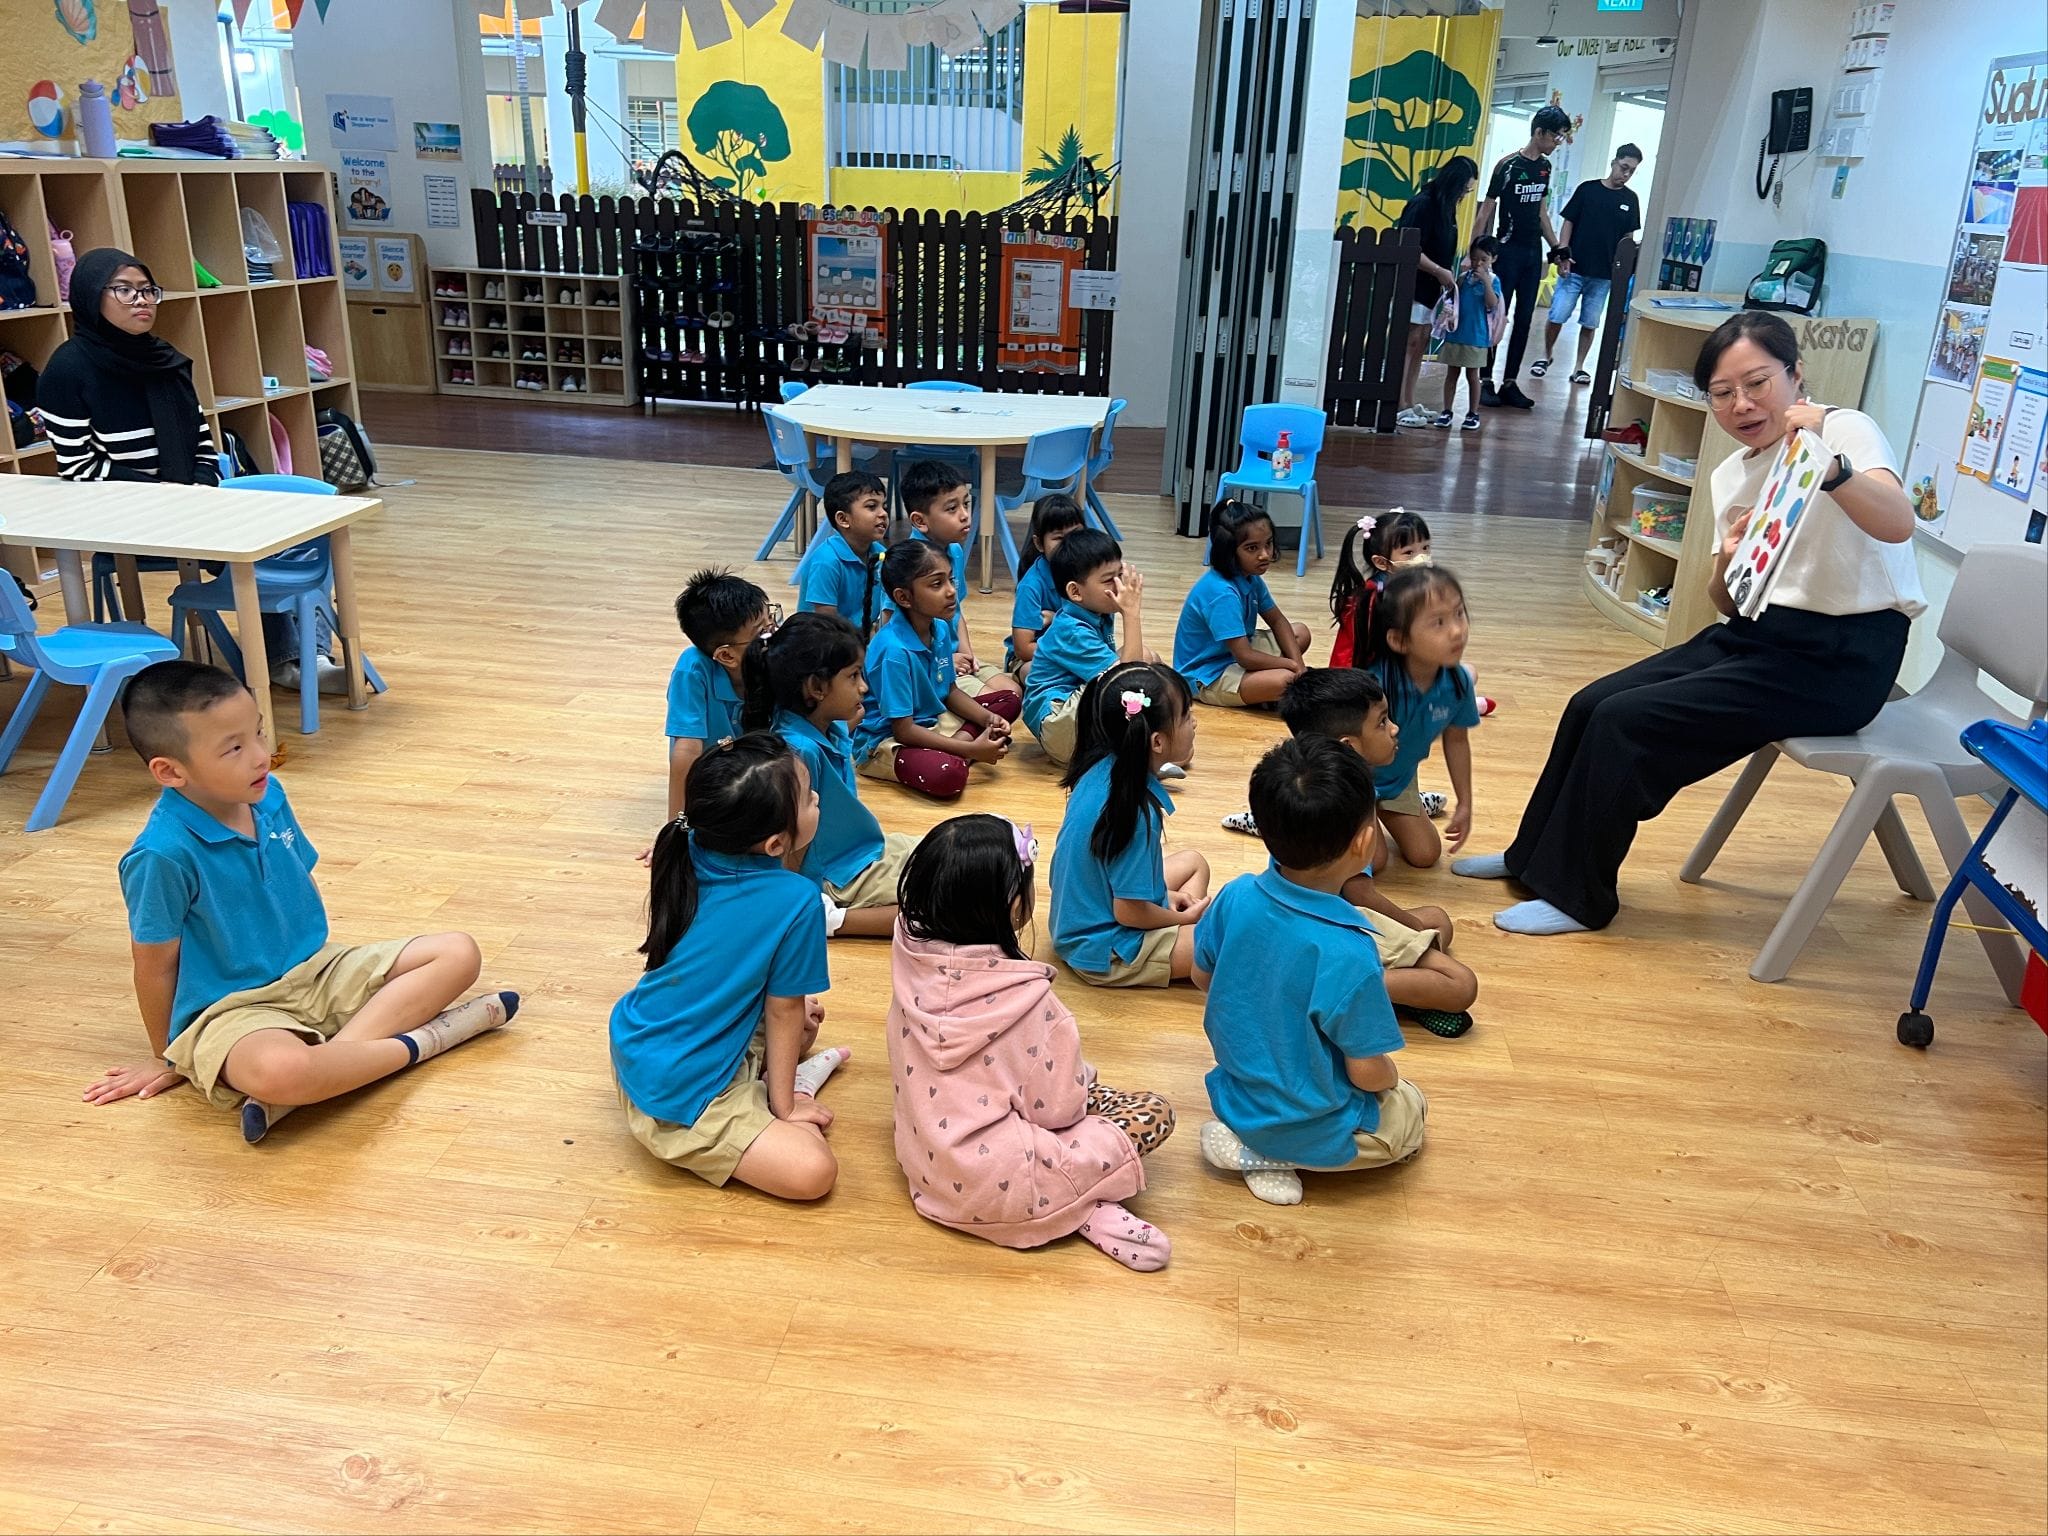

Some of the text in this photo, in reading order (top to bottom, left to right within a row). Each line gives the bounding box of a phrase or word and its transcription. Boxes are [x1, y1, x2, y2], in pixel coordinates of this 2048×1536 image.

[1558, 40, 1574, 57] Our
[343, 156, 385, 168] Welcome
[352, 168, 375, 177] to the
[1000, 228, 1084, 251] Tamil Language
[1800, 319, 1869, 353] Kata
